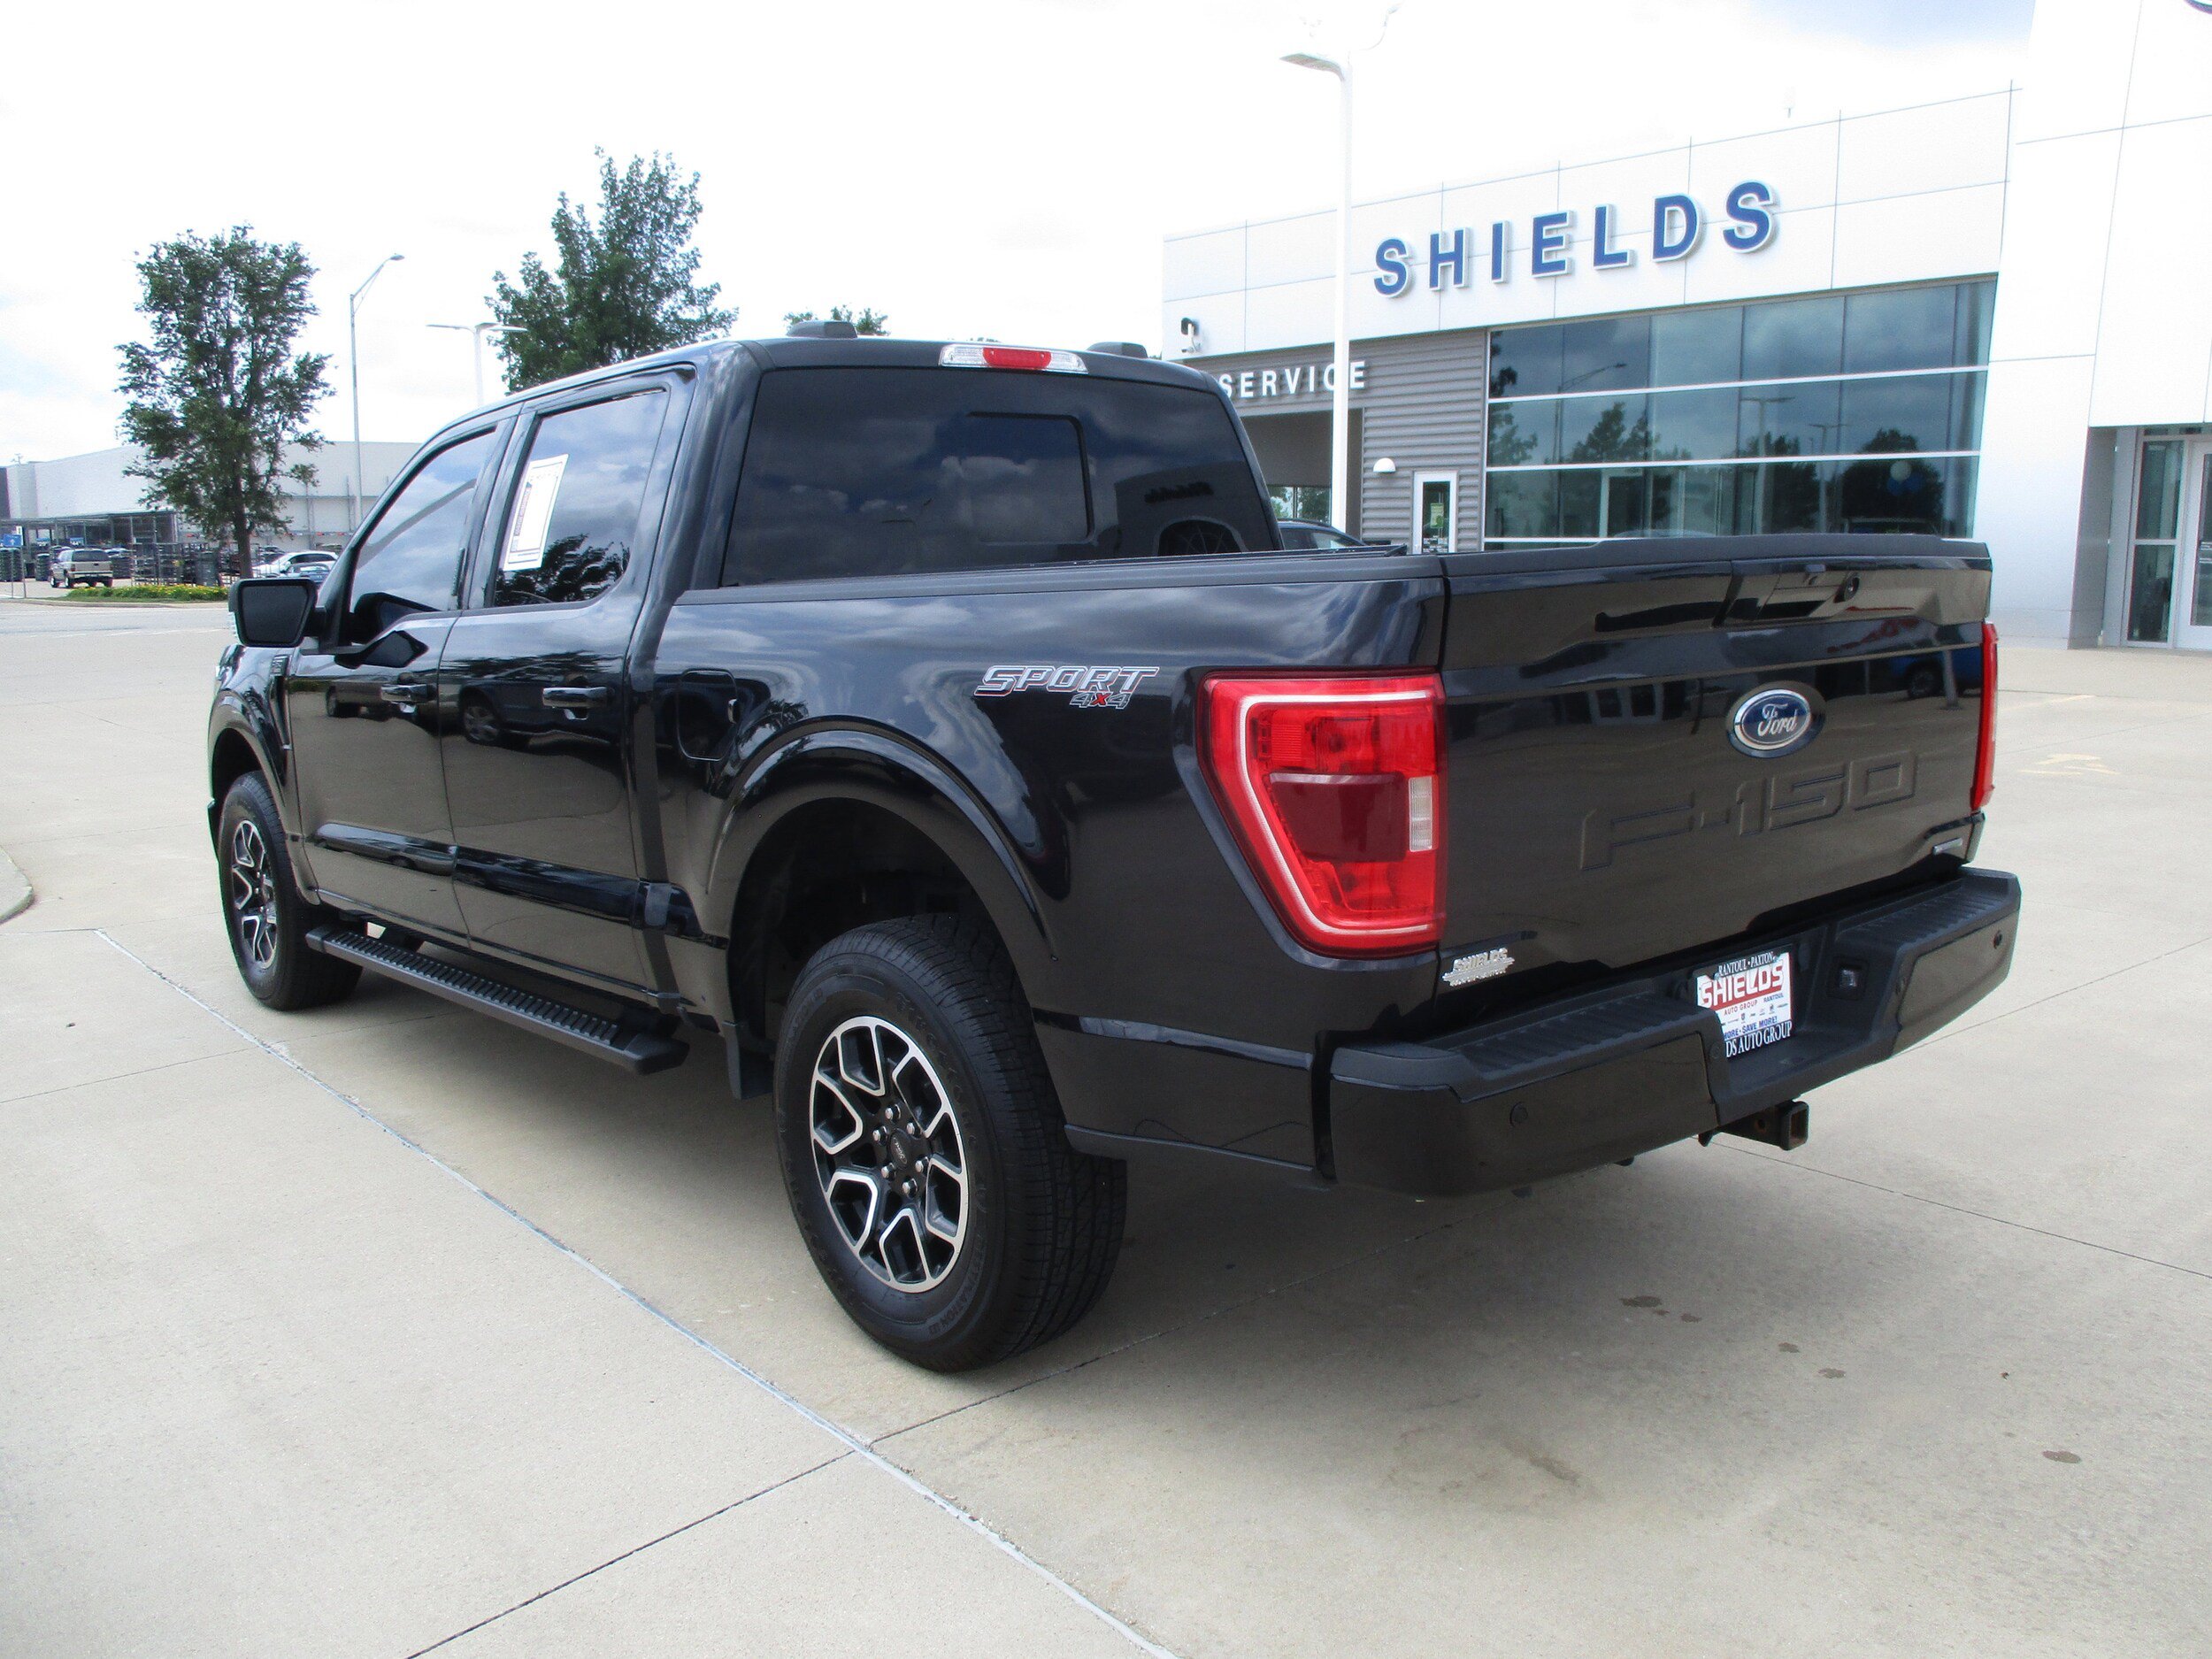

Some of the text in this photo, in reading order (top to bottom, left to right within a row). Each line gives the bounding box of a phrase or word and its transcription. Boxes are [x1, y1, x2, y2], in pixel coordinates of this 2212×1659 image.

[1374, 180, 1776, 299] SHIELDS
[1218, 360, 1365, 398] SERVICE
[974, 665, 1160, 696] SPORT
[1758, 703, 1798, 736] Ford
[1580, 750, 1916, 872] F-150
[1718, 951, 1774, 977] RANTOUL PAXTON
[1701, 960, 1785, 1008] SHIELDS
[1724, 1005, 1739, 1016] AUTO
[1740, 1000, 1757, 1010] GROUP
[1738, 1030, 1763, 1054] AUTO
